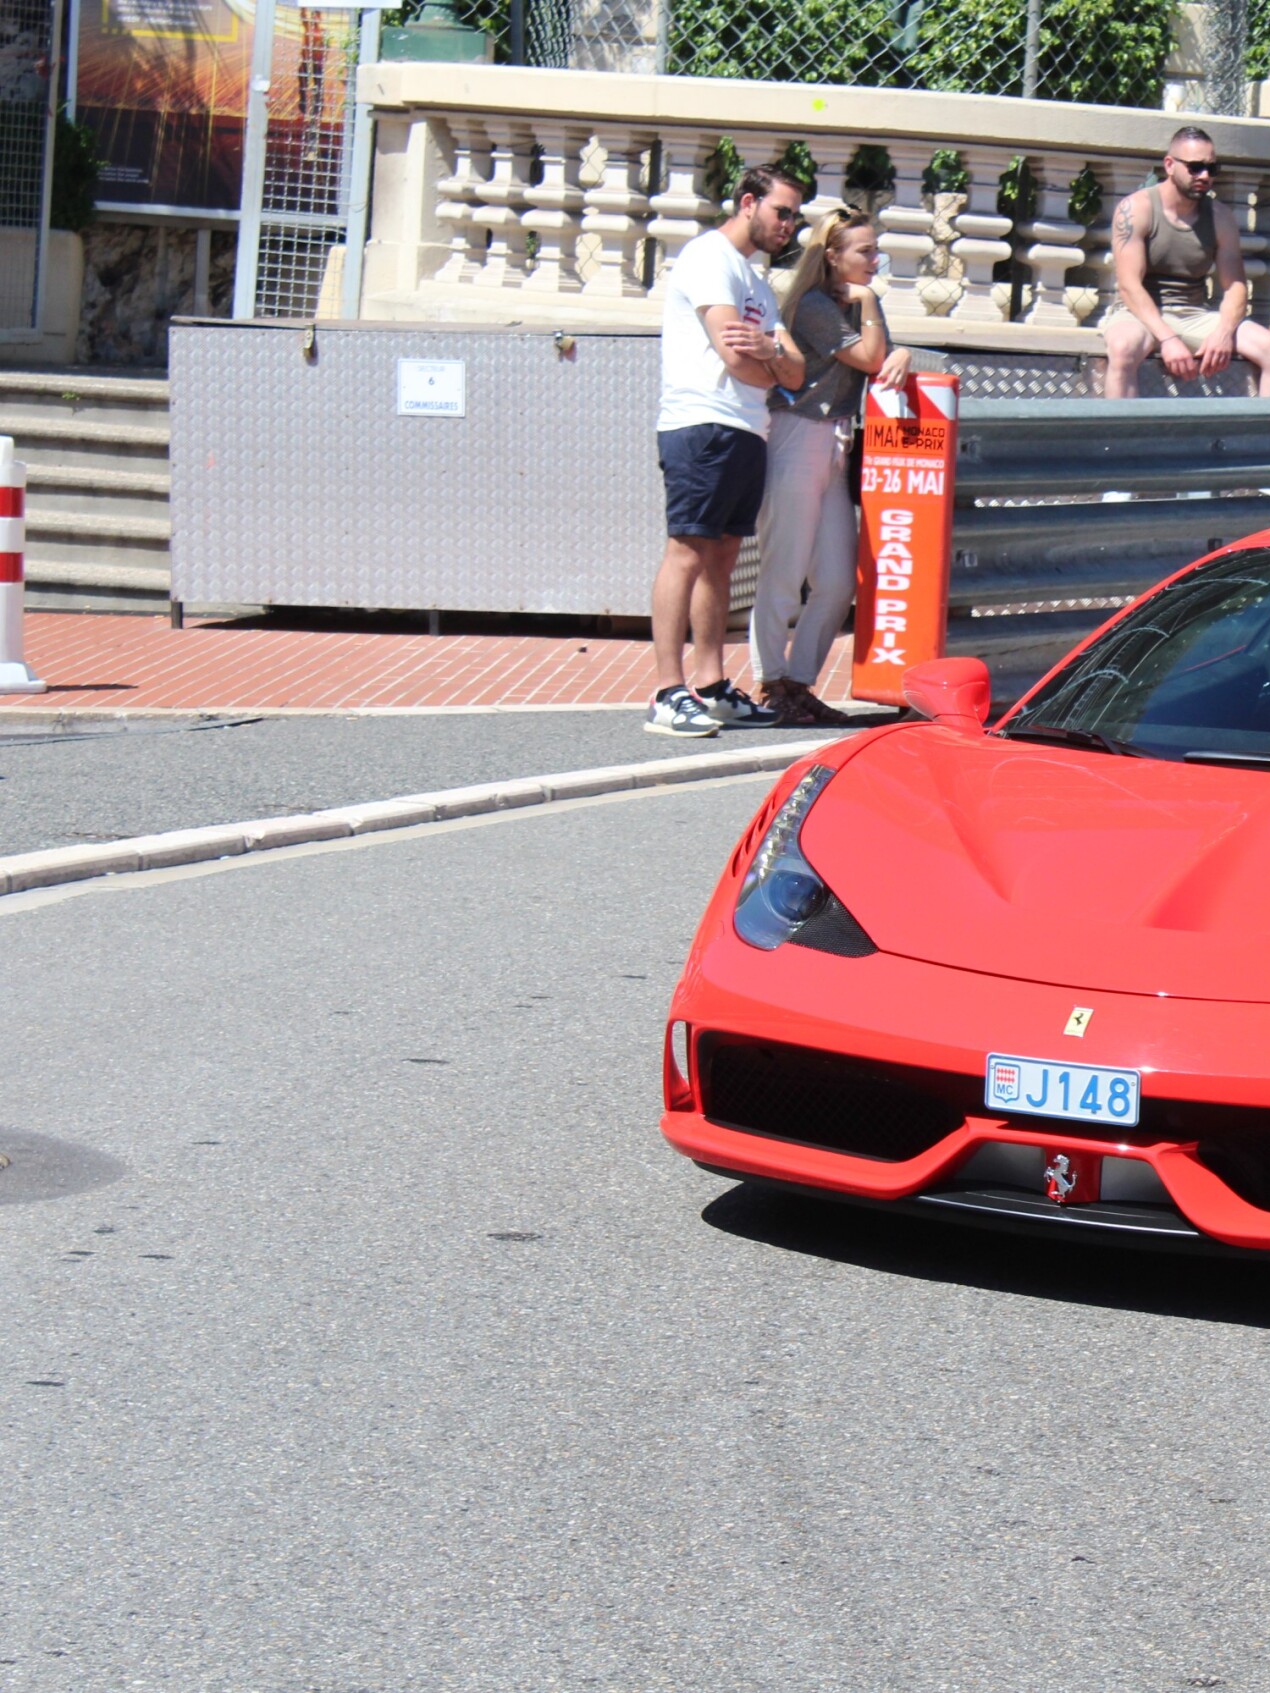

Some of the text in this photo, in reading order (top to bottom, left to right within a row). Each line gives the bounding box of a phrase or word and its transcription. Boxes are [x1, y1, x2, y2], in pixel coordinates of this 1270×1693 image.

[428, 376, 435, 386] 6
[404, 400, 459, 411] COMMISSAIRES
[902, 425, 945, 438] MONACO
[901, 436, 945, 451] E-PRIX
[861, 467, 945, 496] 23-26 MAI
[872, 508, 914, 666] GRAND PRIX
[996, 1084, 1014, 1096] MC
[1026, 1068, 1131, 1118] J148
